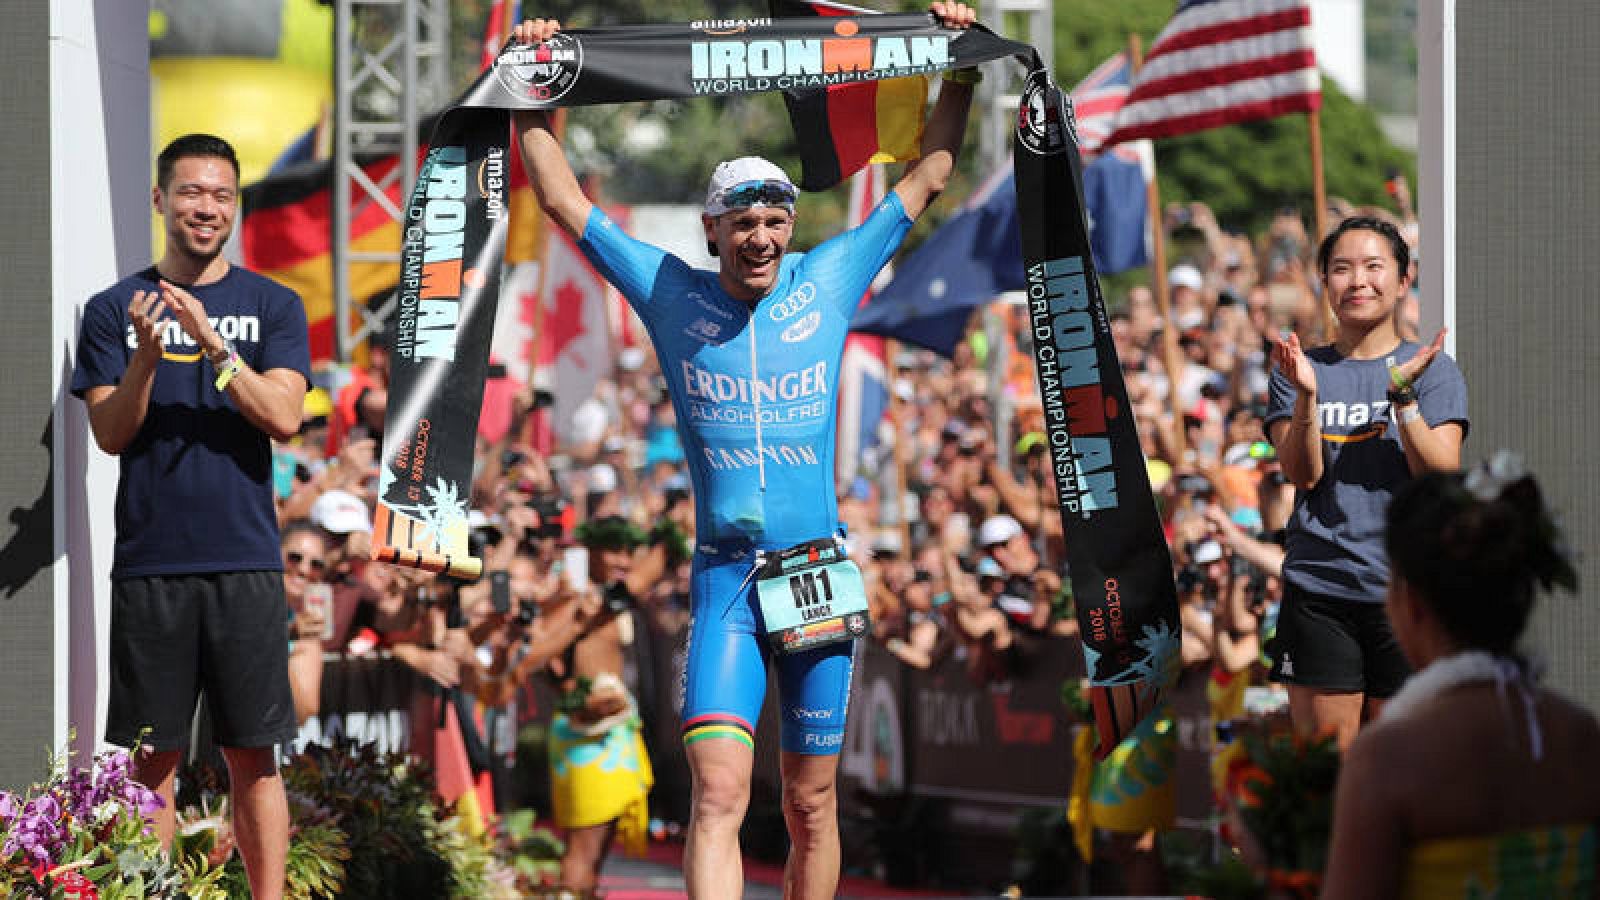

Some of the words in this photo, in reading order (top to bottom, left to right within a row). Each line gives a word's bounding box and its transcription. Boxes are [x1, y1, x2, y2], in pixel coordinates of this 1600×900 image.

[691, 20, 949, 79] IRONMAN
[693, 77, 771, 94] WORLD
[486, 147, 503, 219] amazon
[415, 146, 483, 360] IRONMAN
[397, 225, 423, 359] CHAMPIONSHIP
[1028, 263, 1052, 341] WORLD
[127, 315, 259, 349] amzon
[681, 360, 827, 404] ERDINGER
[1043, 256, 1119, 511] IRONMAN
[1039, 345, 1079, 512] CHAMPIONSHIP
[789, 567, 833, 608] M1
